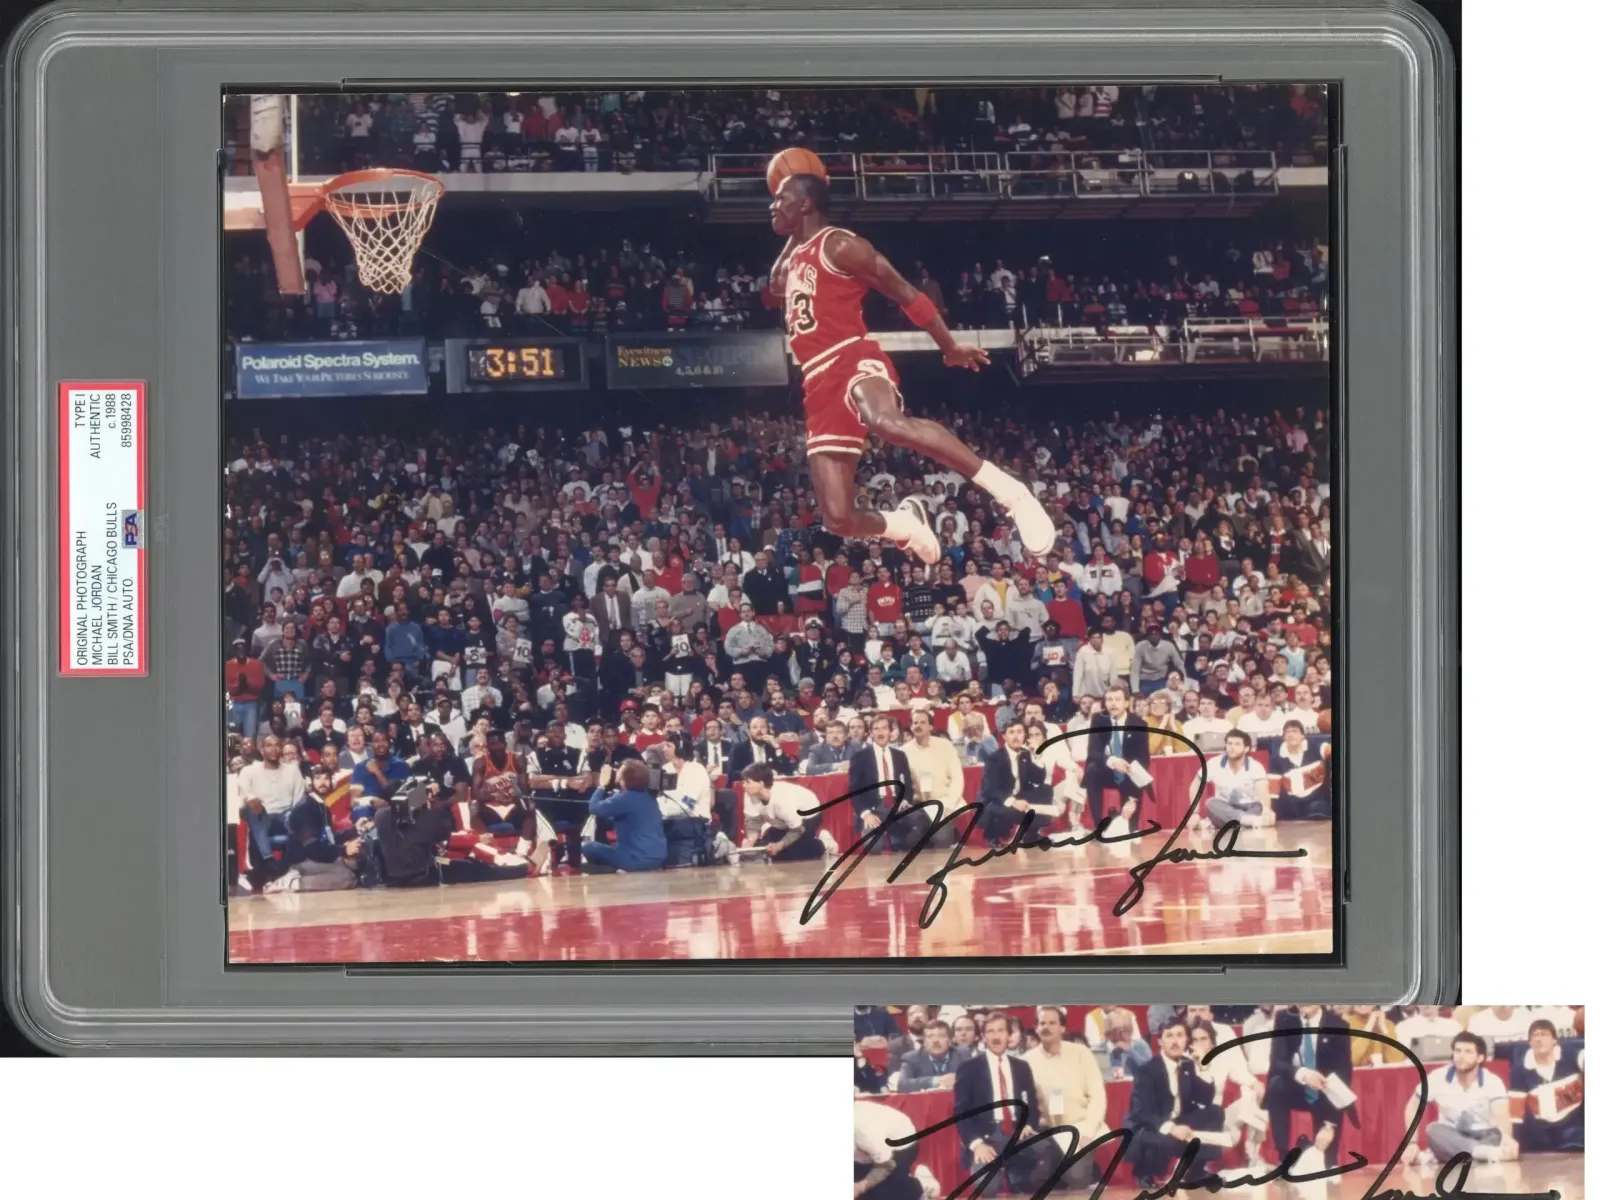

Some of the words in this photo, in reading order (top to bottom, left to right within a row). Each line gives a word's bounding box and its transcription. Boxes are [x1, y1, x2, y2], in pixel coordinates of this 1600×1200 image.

[242, 356, 302, 370] Polaroid
[304, 354, 361, 370] Spectra
[363, 352, 420, 368] System.
[486, 347, 554, 378] 3:51
[618, 357, 662, 367] NEWS
[75, 400, 85, 428] TYPE
[90, 393, 101, 459] AUTHENTIC
[121, 393, 132, 448] 85998428
[106, 502, 117, 538] BULLS
[125, 512, 139, 546] PSA
[76, 531, 88, 610] PHOTOGRAPH
[106, 540, 117, 593] CHICAGO
[91, 565, 102, 611] JORDAN
[77, 613, 88, 666] ORIGINAL
[91, 615, 103, 666] MICHAEL
[107, 603, 118, 639] SMITH
[122, 614, 134, 665] PSA/DNA
[107, 642, 118, 665] BILL
